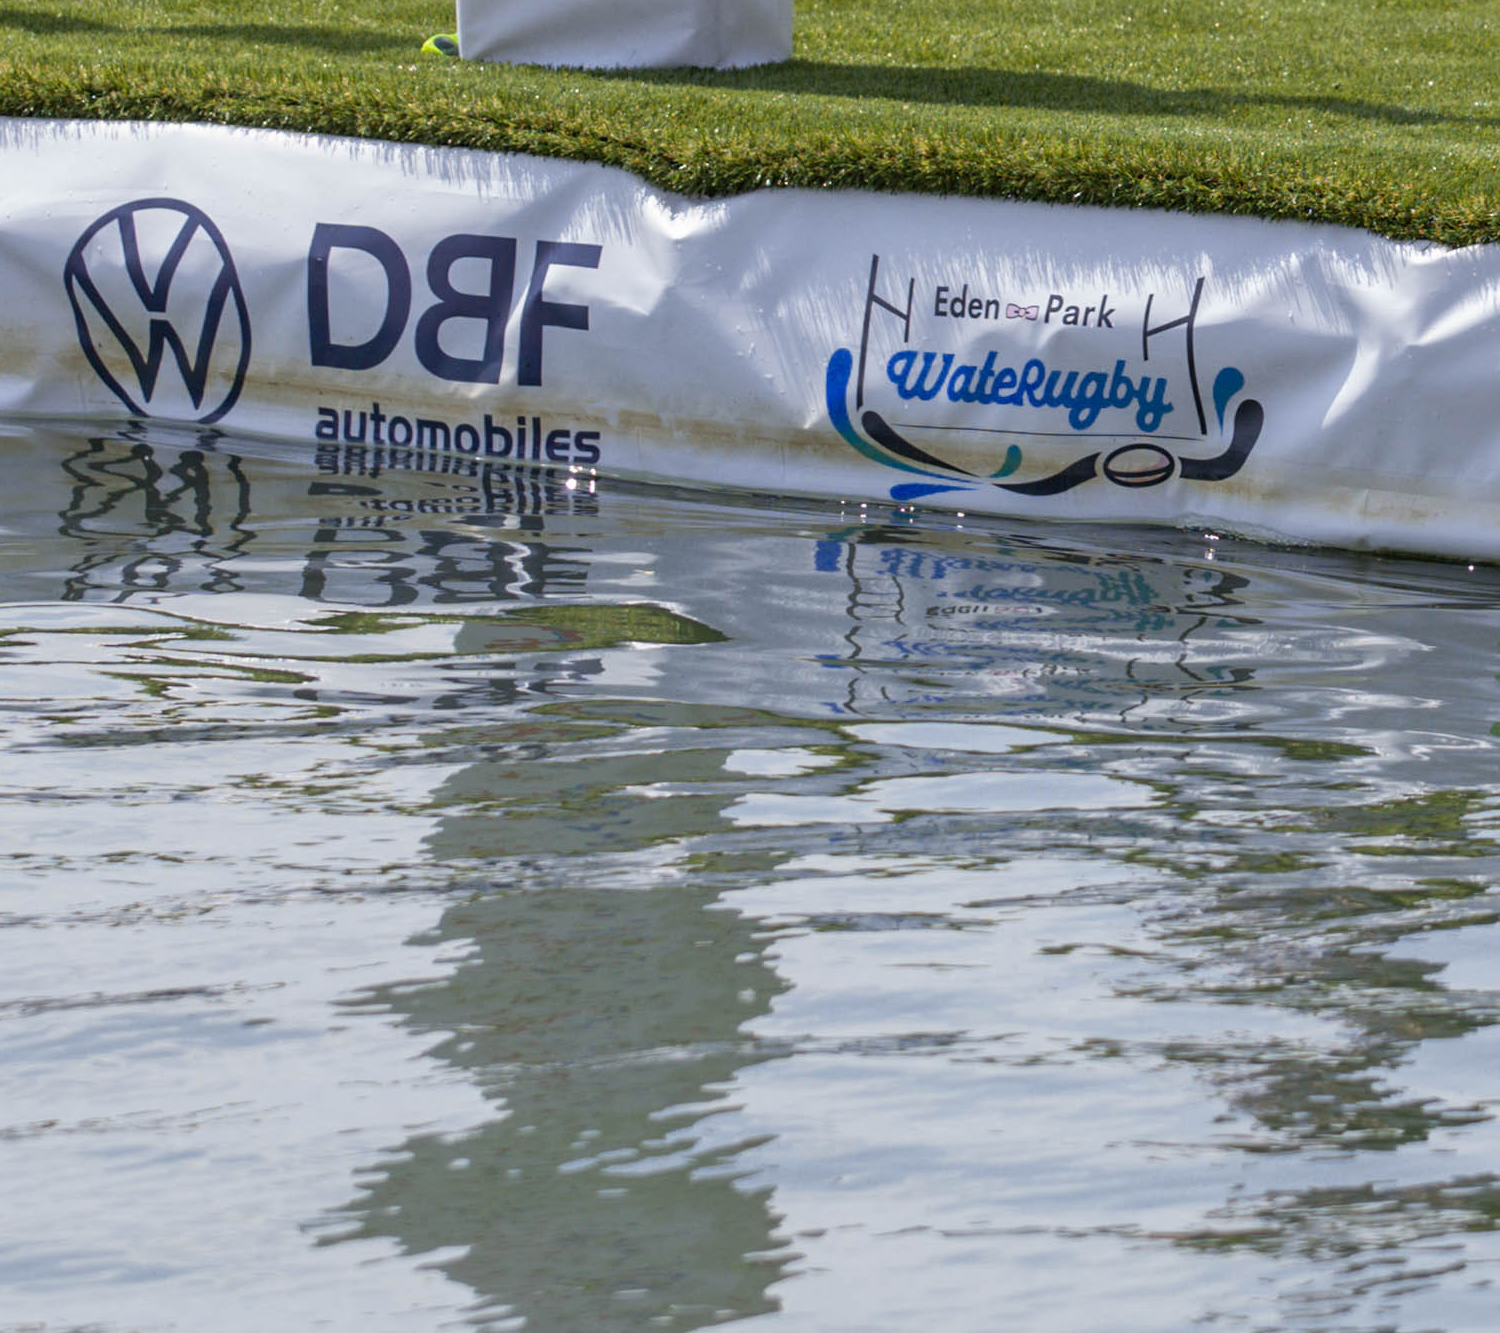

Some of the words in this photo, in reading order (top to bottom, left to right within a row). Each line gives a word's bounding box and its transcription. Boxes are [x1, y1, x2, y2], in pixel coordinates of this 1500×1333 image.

[308, 222, 603, 388] DBF
[934, 283, 1000, 321] Eden
[1044, 293, 1116, 330] Park
[886, 349, 1174, 434] WateRugby
[314, 401, 602, 465] automobiles
